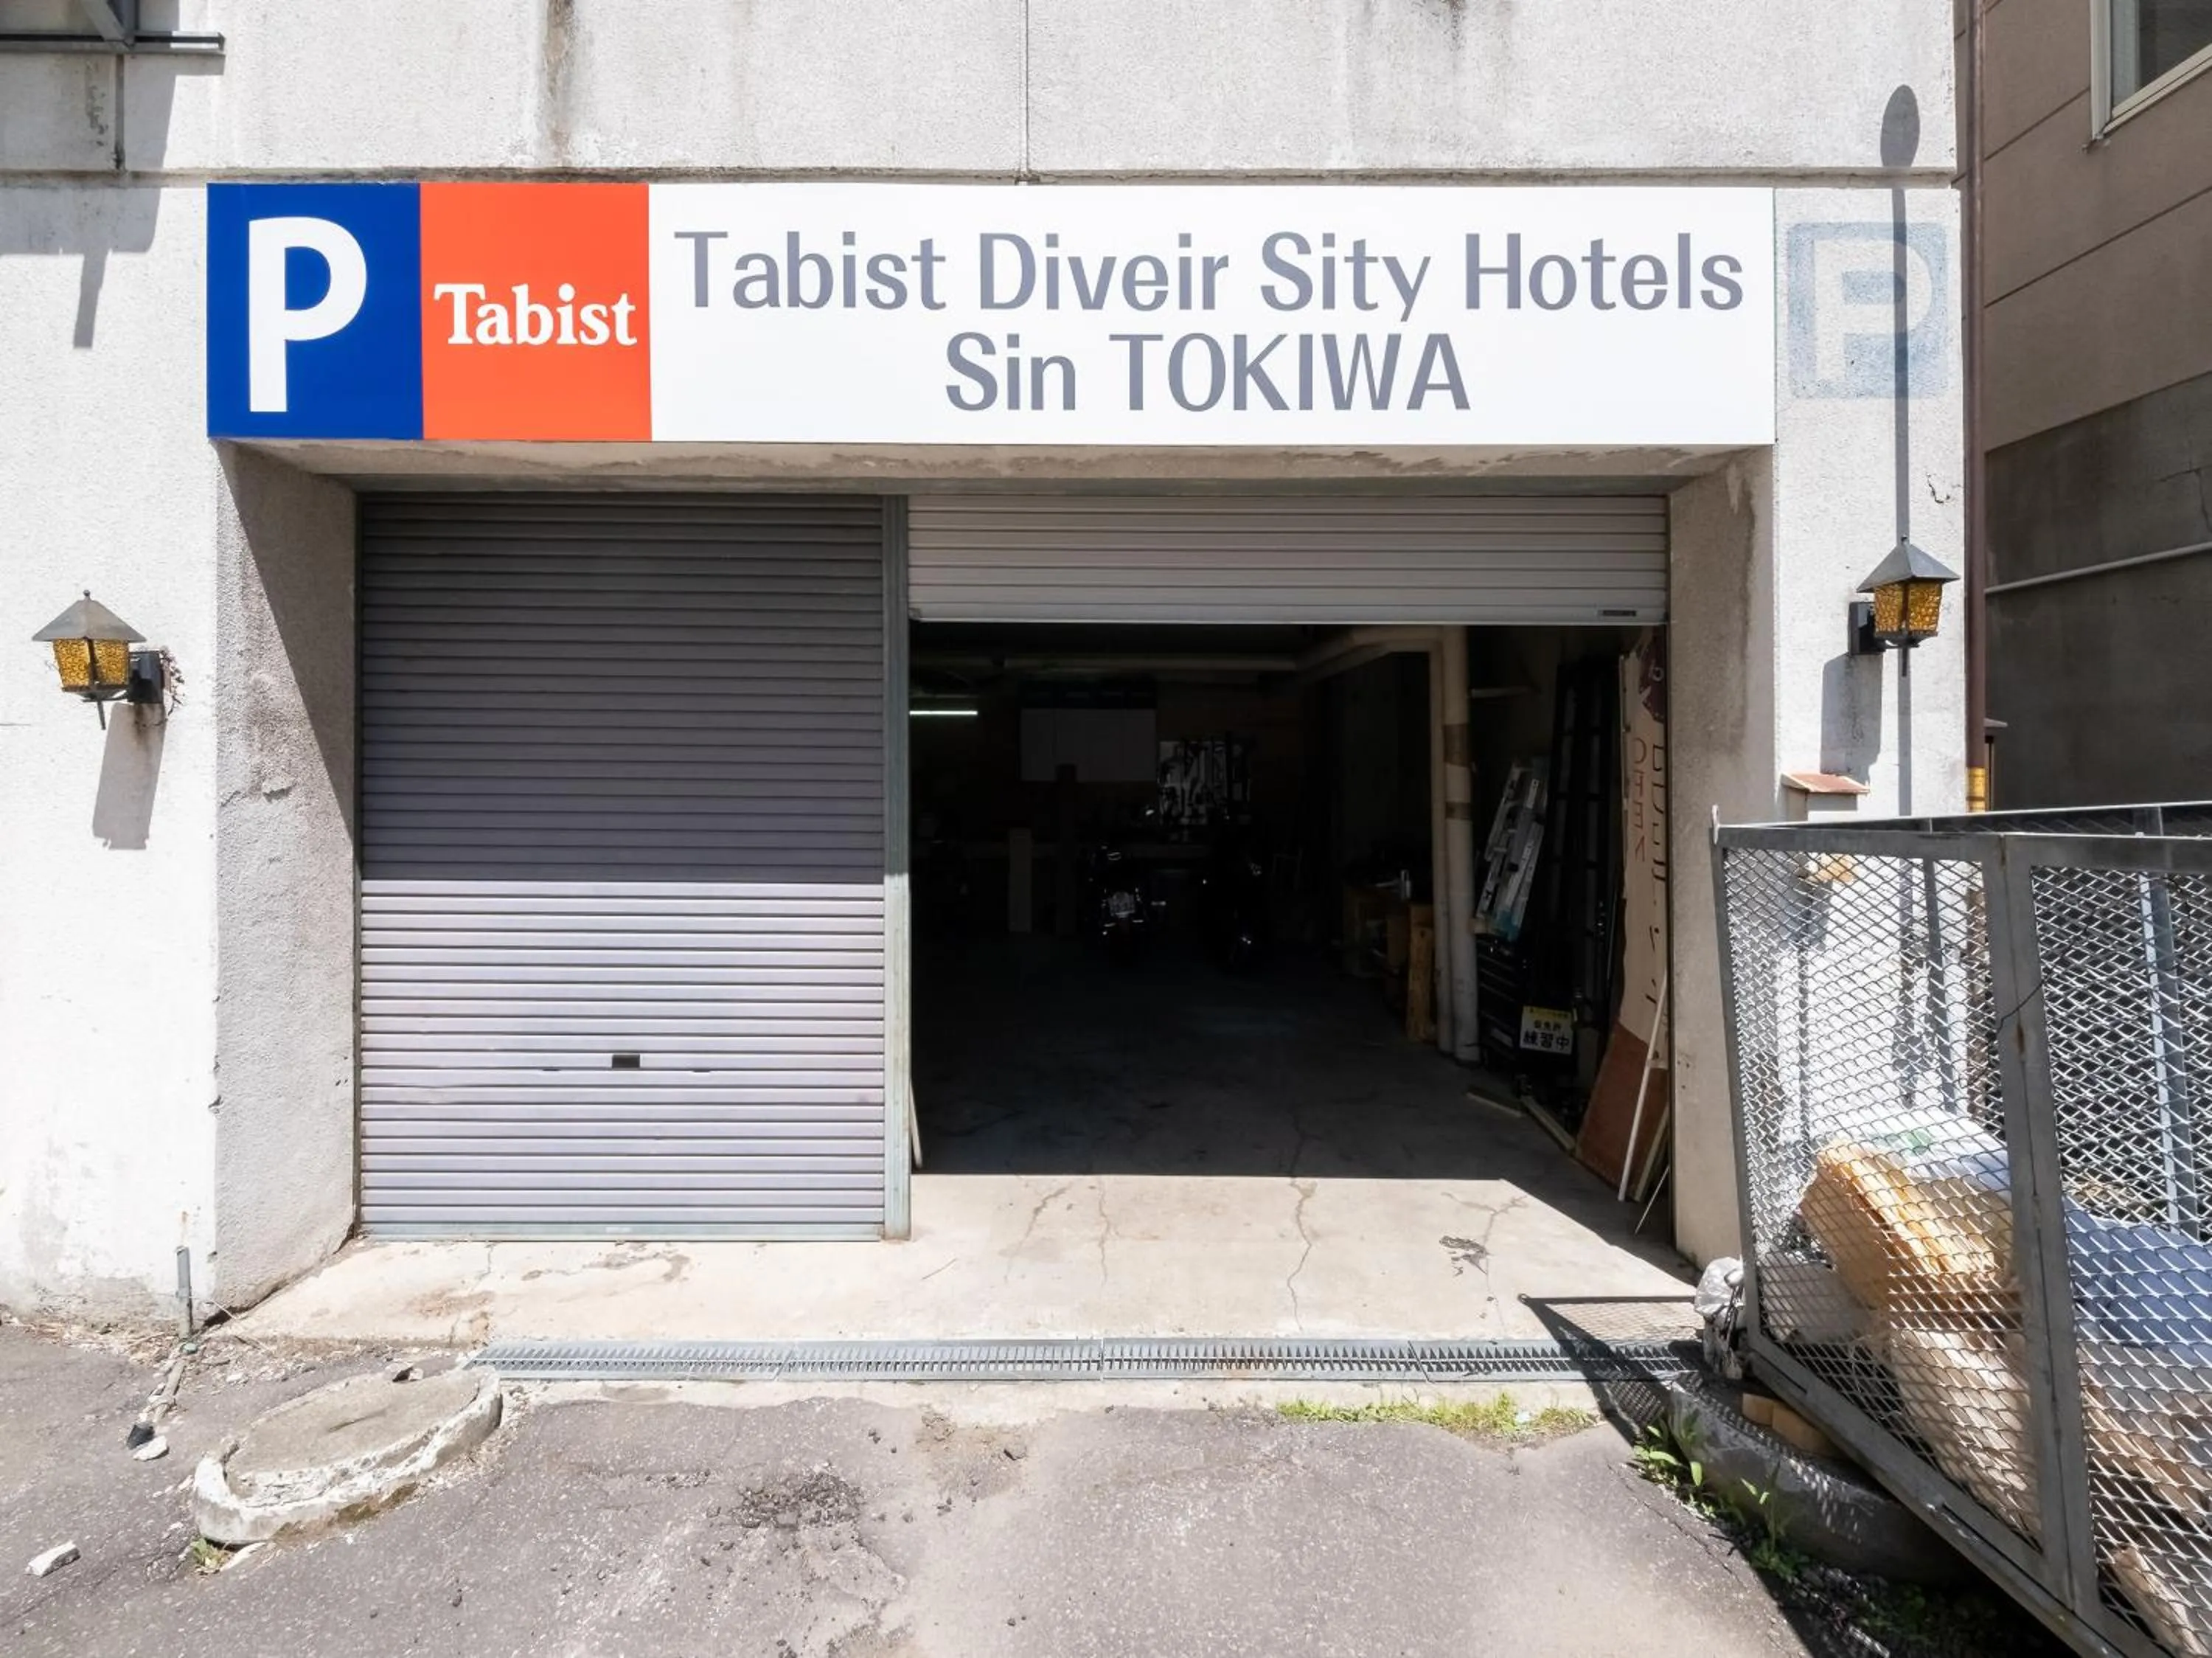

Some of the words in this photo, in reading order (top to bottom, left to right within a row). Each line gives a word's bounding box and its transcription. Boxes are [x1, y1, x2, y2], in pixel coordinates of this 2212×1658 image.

[249, 217, 366, 412] P
[434, 283, 638, 346] Tabist
[675, 232, 946, 310] Tabist
[981, 233, 1228, 311] Diveir
[1261, 232, 1430, 322] Sity
[1467, 233, 1742, 311] Hotels
[1813, 239, 1933, 379] P
[946, 332, 1075, 411] Sin
[1109, 333, 1470, 412] TOKIWA
